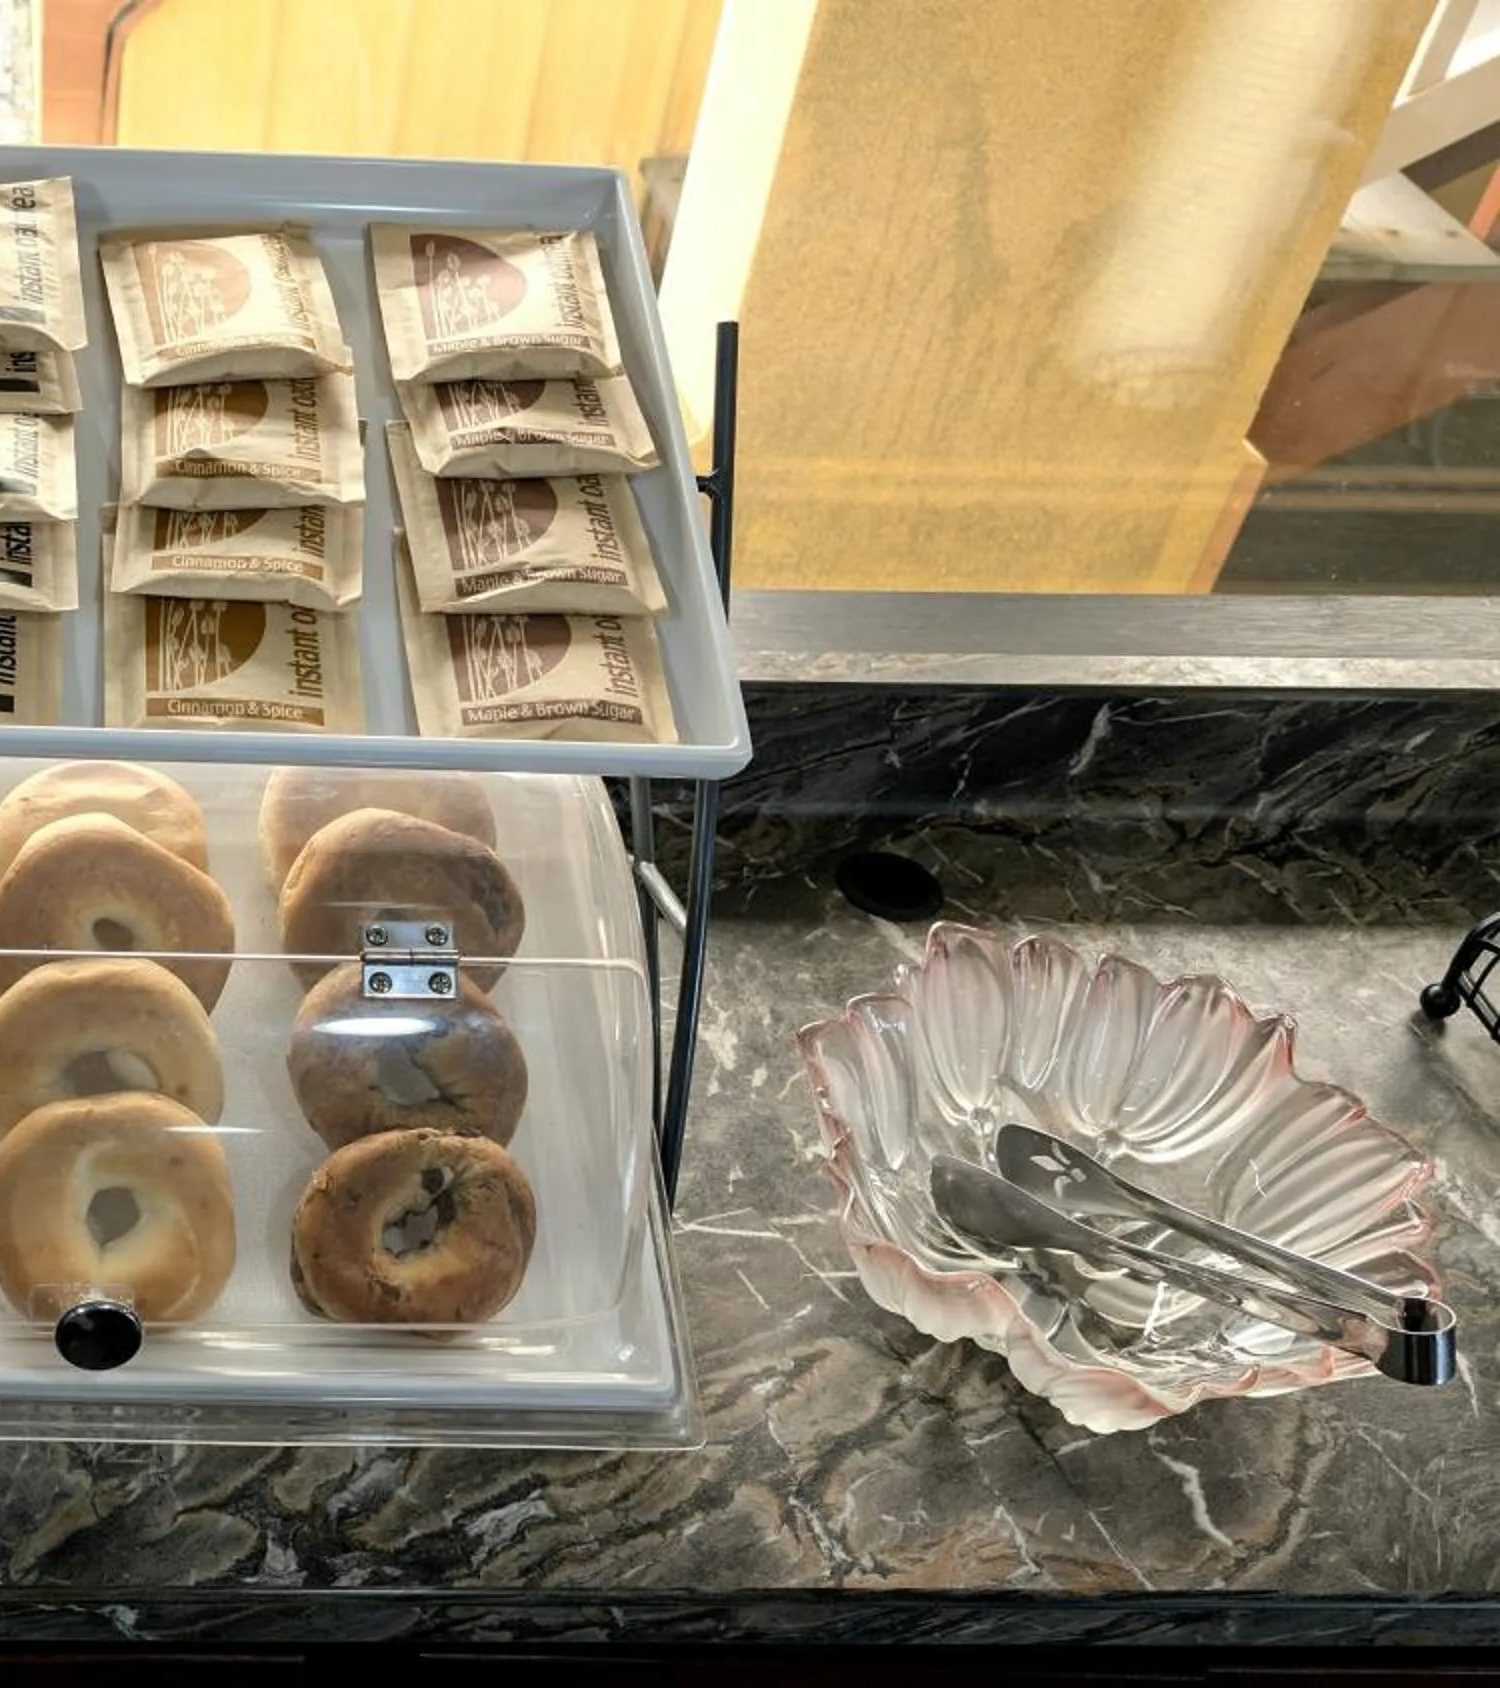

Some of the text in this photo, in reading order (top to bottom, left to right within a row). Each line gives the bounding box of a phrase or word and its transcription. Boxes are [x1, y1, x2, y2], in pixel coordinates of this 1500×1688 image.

[292, 504, 326, 558] instan
[172, 554, 247, 570] Cinnamon
[285, 628, 323, 699] instant
[592, 632, 638, 698] instant
[167, 699, 304, 720] Cinnamon & Spice
[467, 701, 637, 723] Maple & Brown Sugar
